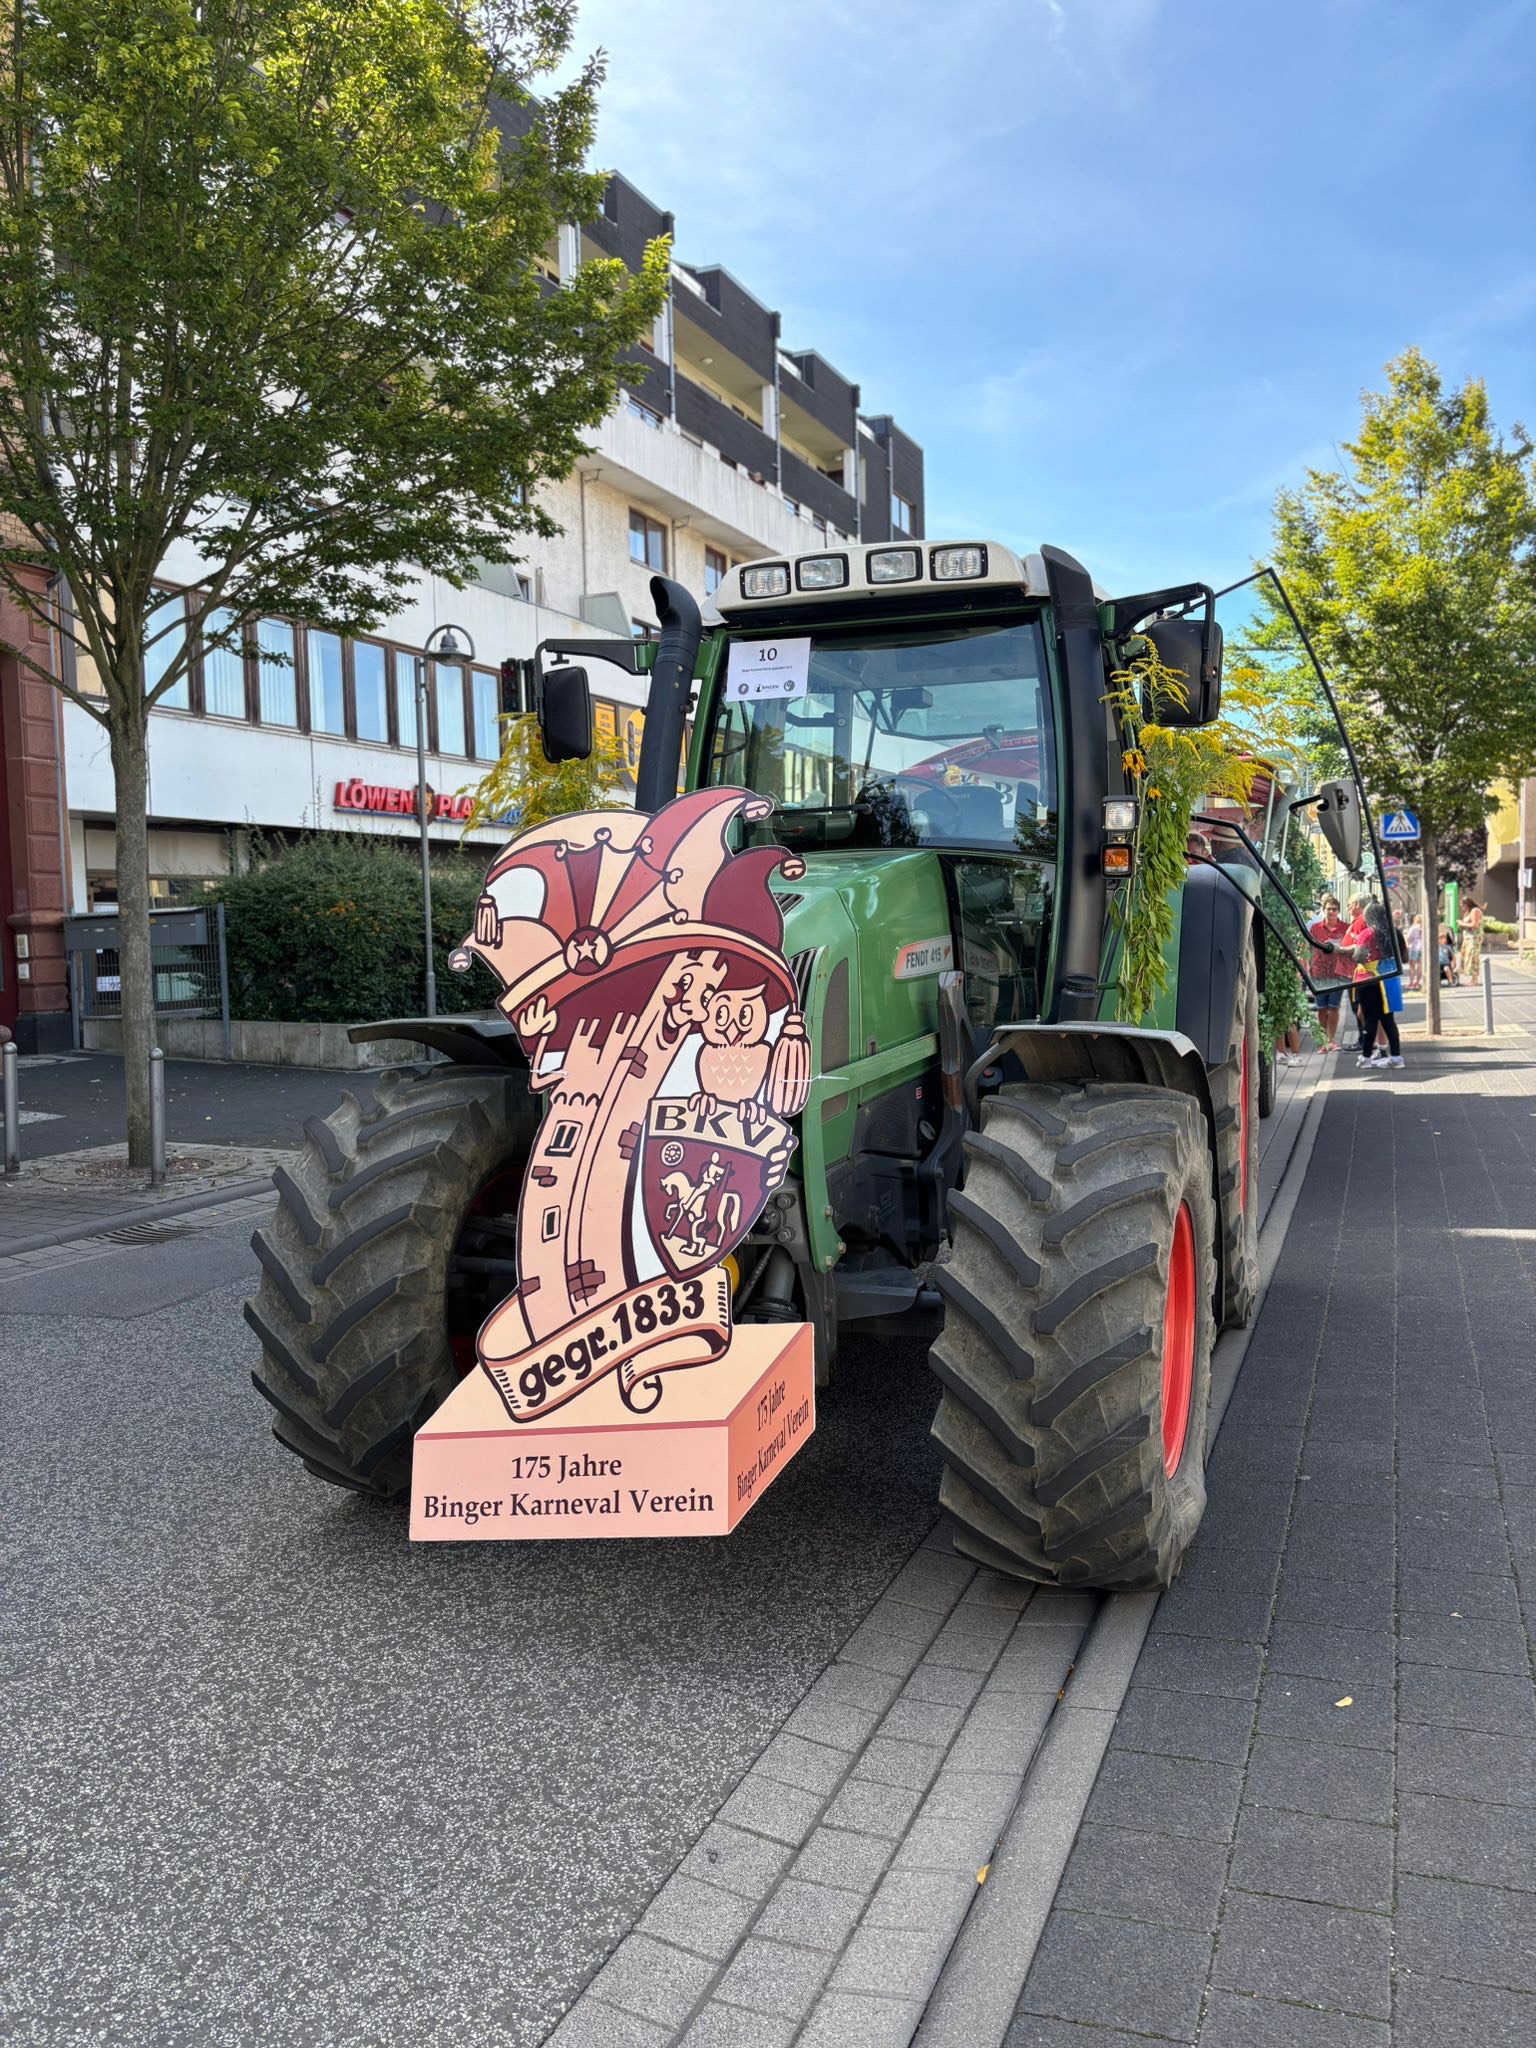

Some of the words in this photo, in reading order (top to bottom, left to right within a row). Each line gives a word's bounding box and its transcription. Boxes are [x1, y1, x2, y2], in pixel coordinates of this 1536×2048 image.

[759, 648, 778, 662] 10
[333, 777, 415, 814] LÖWEN
[906, 948, 929, 969] FENDT
[930, 946, 942, 963] 415
[654, 1105, 776, 1148] BKV
[757, 1394, 769, 1433] 175
[768, 1380, 786, 1426] Jahre
[737, 1463, 757, 1500] Binger
[758, 1417, 786, 1478] Karneval
[786, 1395, 809, 1440] Verein
[511, 1456, 551, 1480] 175
[557, 1453, 623, 1484] Jahre
[423, 1495, 503, 1525] Binger
[510, 1489, 621, 1517] Karneval
[628, 1487, 714, 1514] Verein
